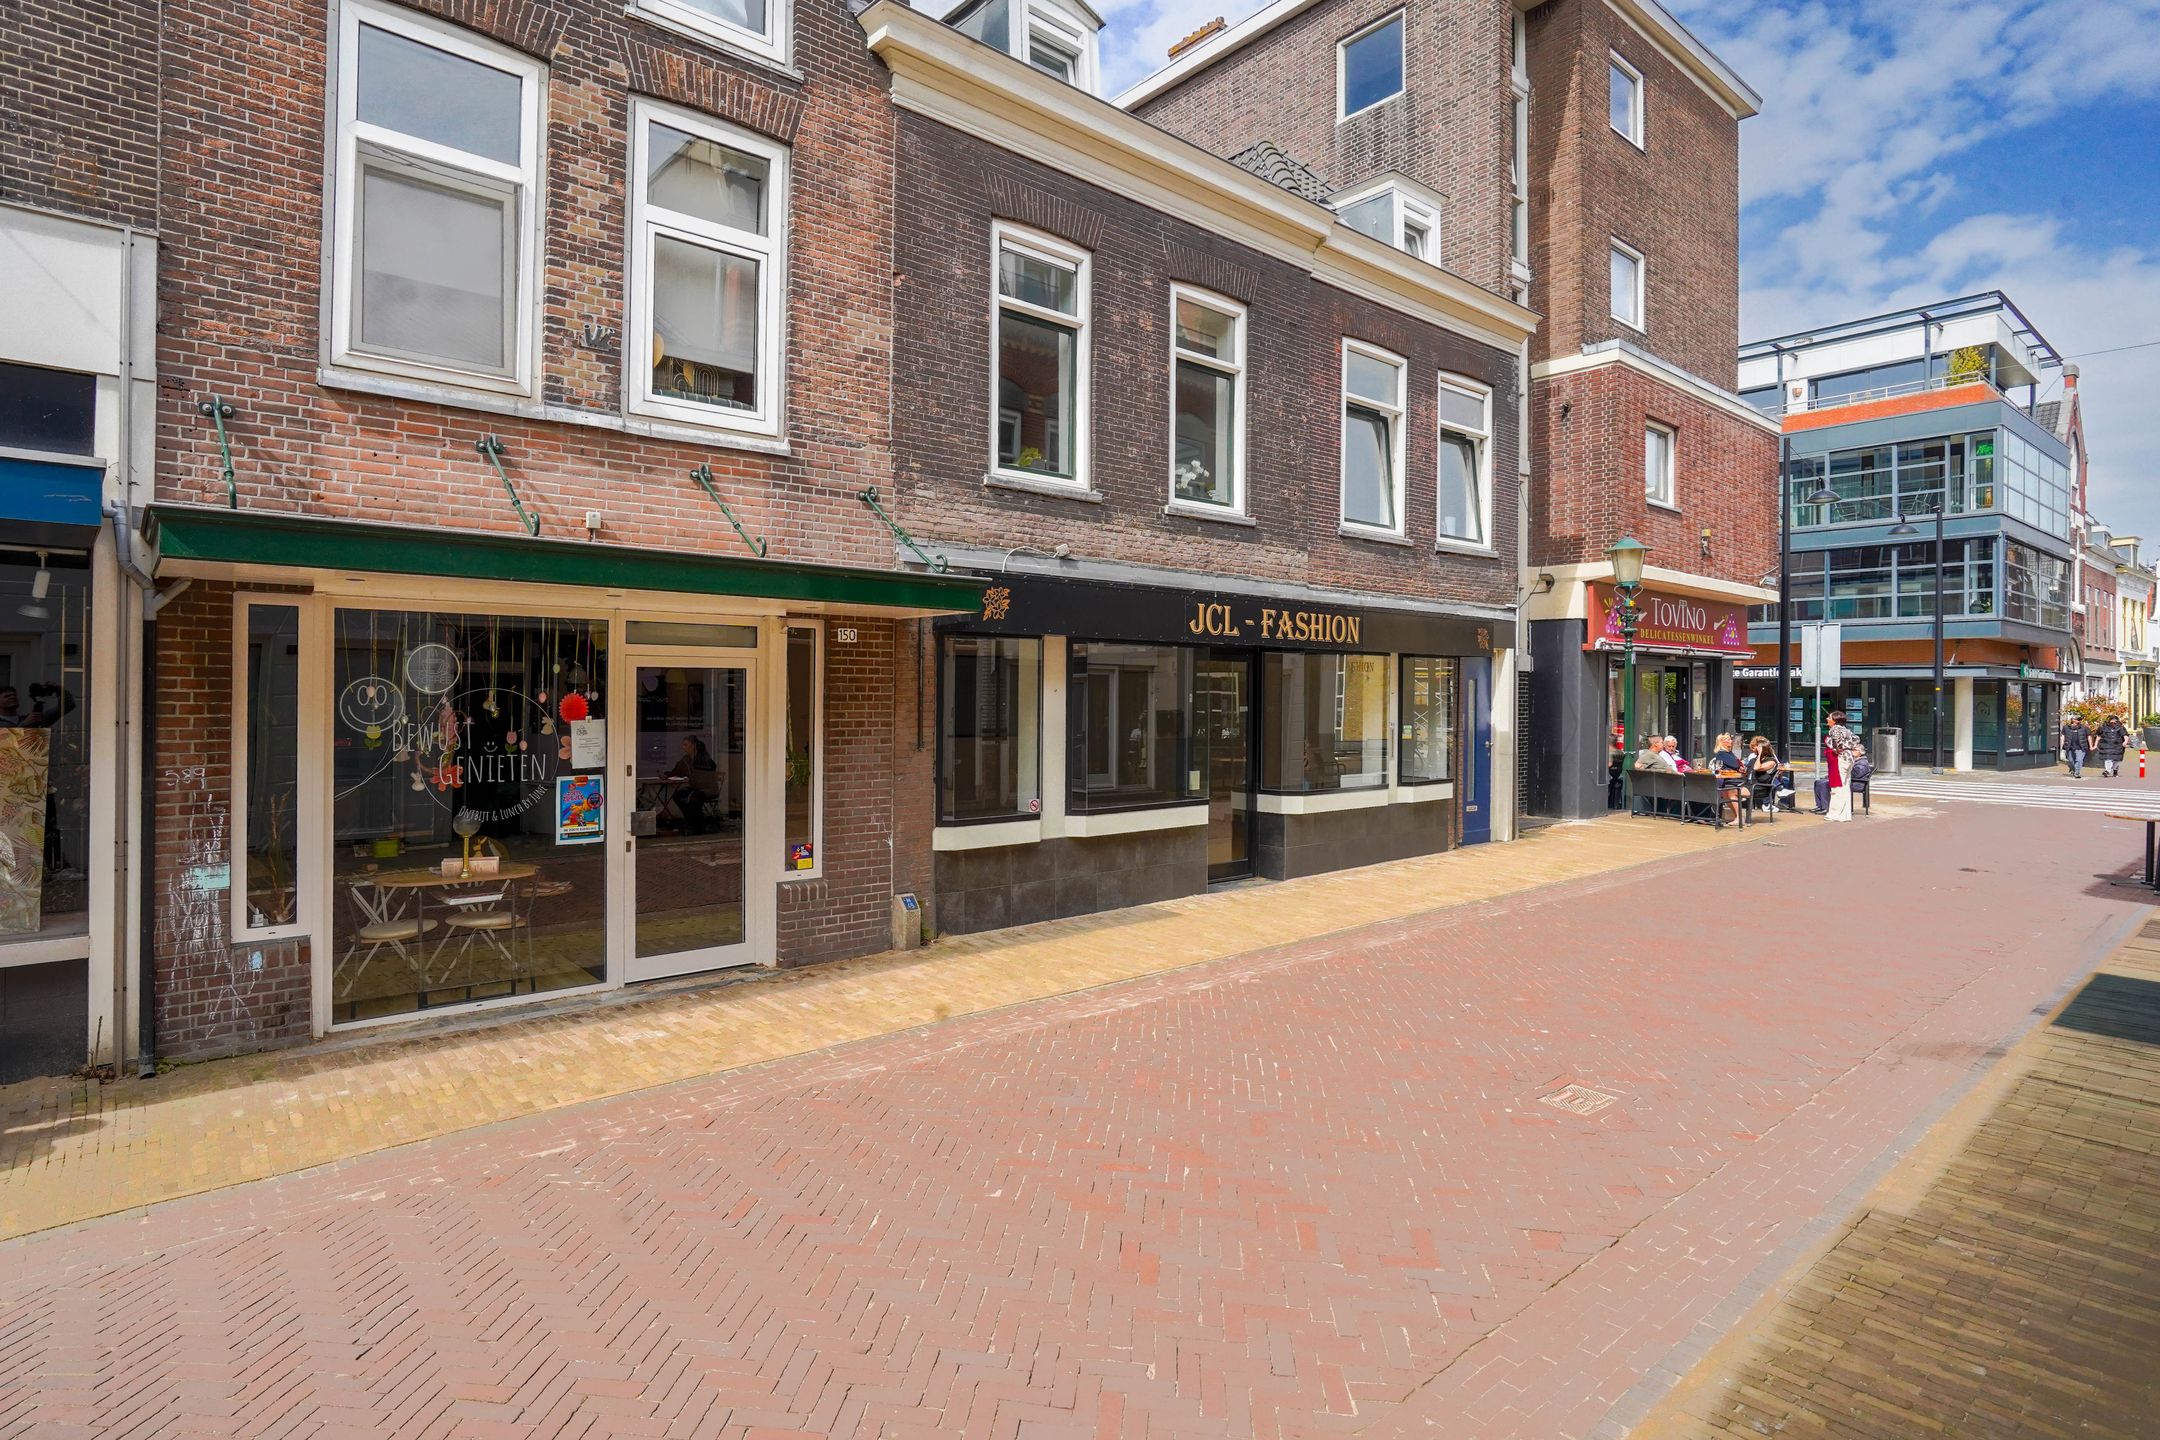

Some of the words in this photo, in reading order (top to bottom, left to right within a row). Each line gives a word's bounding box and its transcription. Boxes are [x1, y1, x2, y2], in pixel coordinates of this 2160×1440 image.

[1189, 603, 1240, 637] JCL
[1261, 608, 1361, 644] FASHION
[1651, 597, 1706, 631] TOVINO
[839, 629, 856, 641] 150
[1640, 628, 1715, 645] DELICATESSENWINKEL
[392, 719, 475, 752] BEWUST
[439, 751, 546, 785] GENIETEN
[491, 810, 498, 822] &
[499, 803, 525, 820] LUNCH
[521, 797, 533, 809] BY
[528, 784, 548, 803] JUNE
